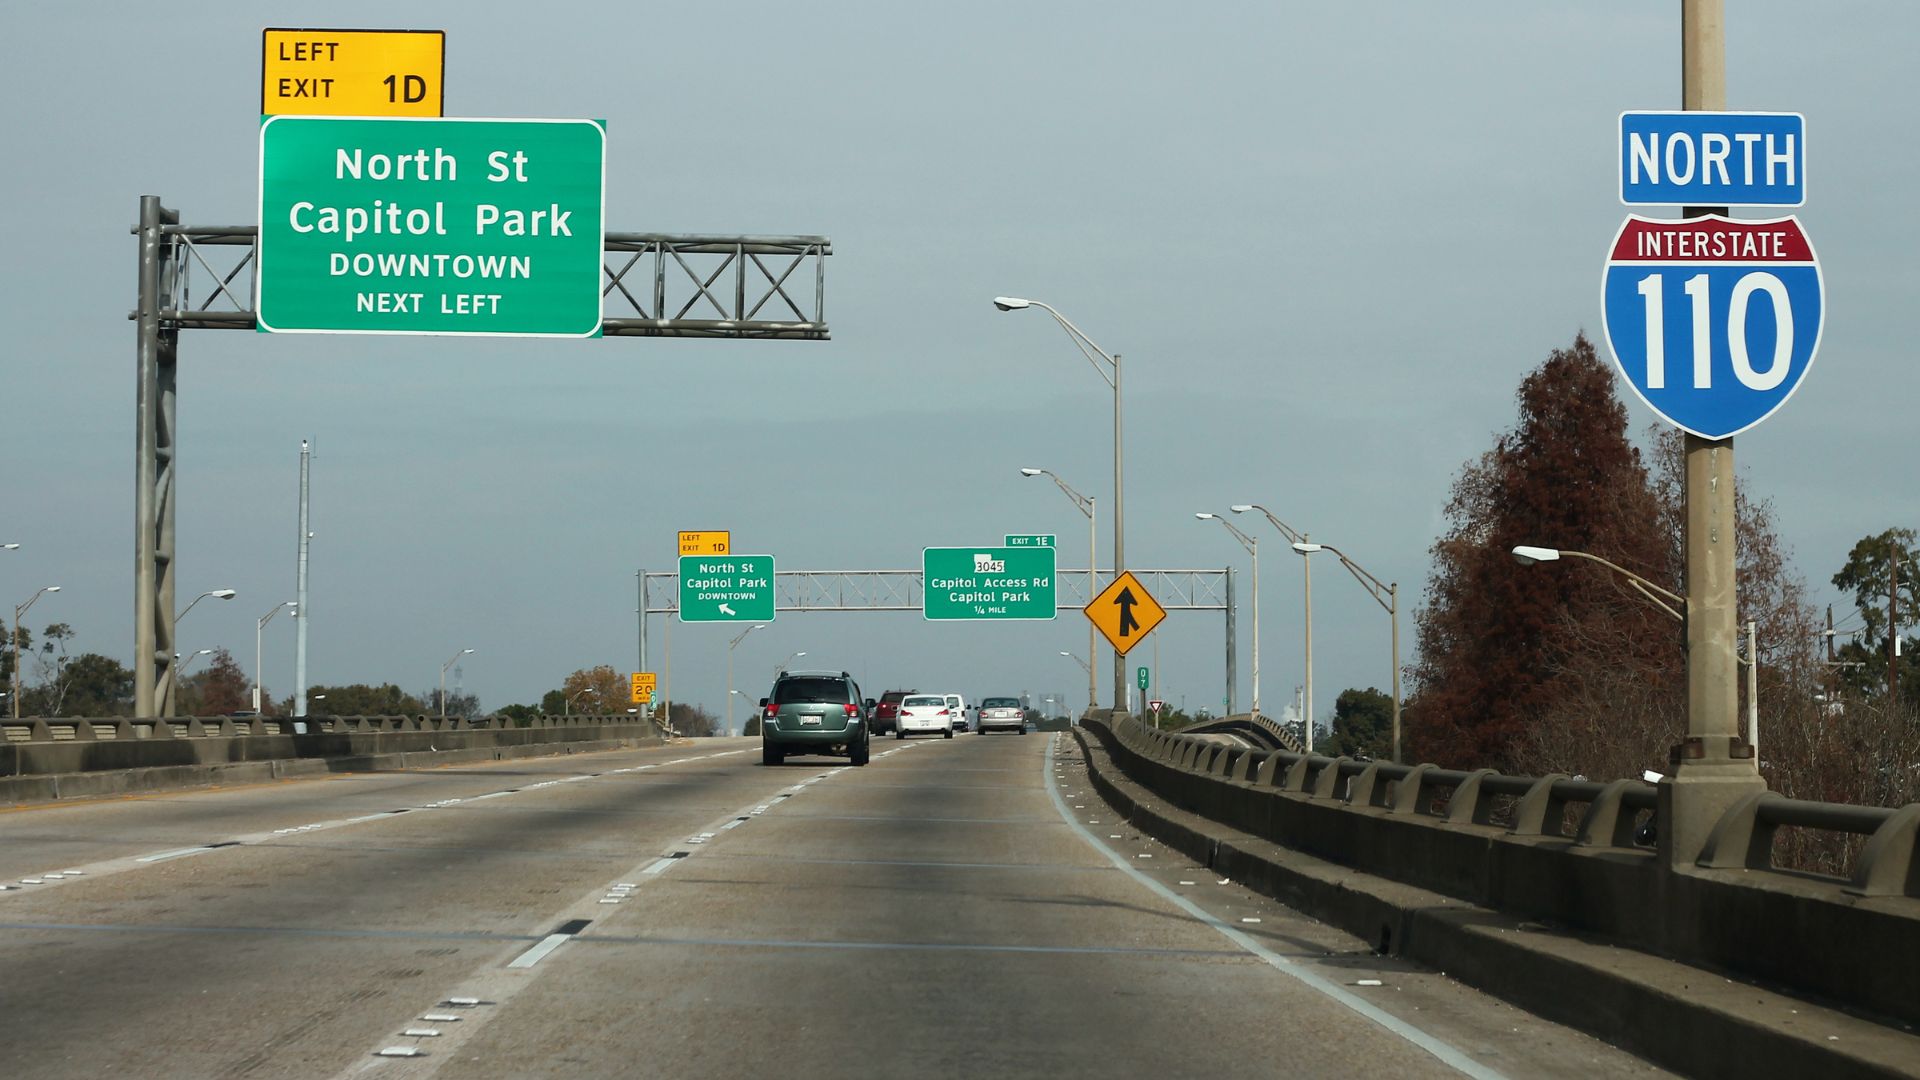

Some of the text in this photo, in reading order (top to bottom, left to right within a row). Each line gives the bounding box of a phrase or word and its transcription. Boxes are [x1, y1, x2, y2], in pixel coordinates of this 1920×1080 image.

[279, 42, 339, 62] LEFT
[278, 74, 427, 103] EXIT 1D
[336, 147, 528, 182] North St
[1629, 131, 1795, 186] NORTH
[289, 199, 573, 242] Capitol Park
[1637, 231, 1787, 257] INTERSTATE
[329, 252, 531, 279] DOWNTOWN
[356, 292, 502, 315] NEXT LEFT
[1637, 271, 1794, 391] 110
[712, 543, 725, 552] 1D
[1035, 537, 1048, 545] 1E
[699, 563, 754, 573] North St
[976, 561, 1003, 571] 3045
[687, 577, 767, 590] Capitol Park
[931, 577, 1049, 590] Capitol Access Rd
[698, 592, 756, 600] DOWNTOWN
[949, 591, 1031, 604] Capitol Park
[988, 606, 1007, 614] MILE
[635, 685, 652, 694] 20
